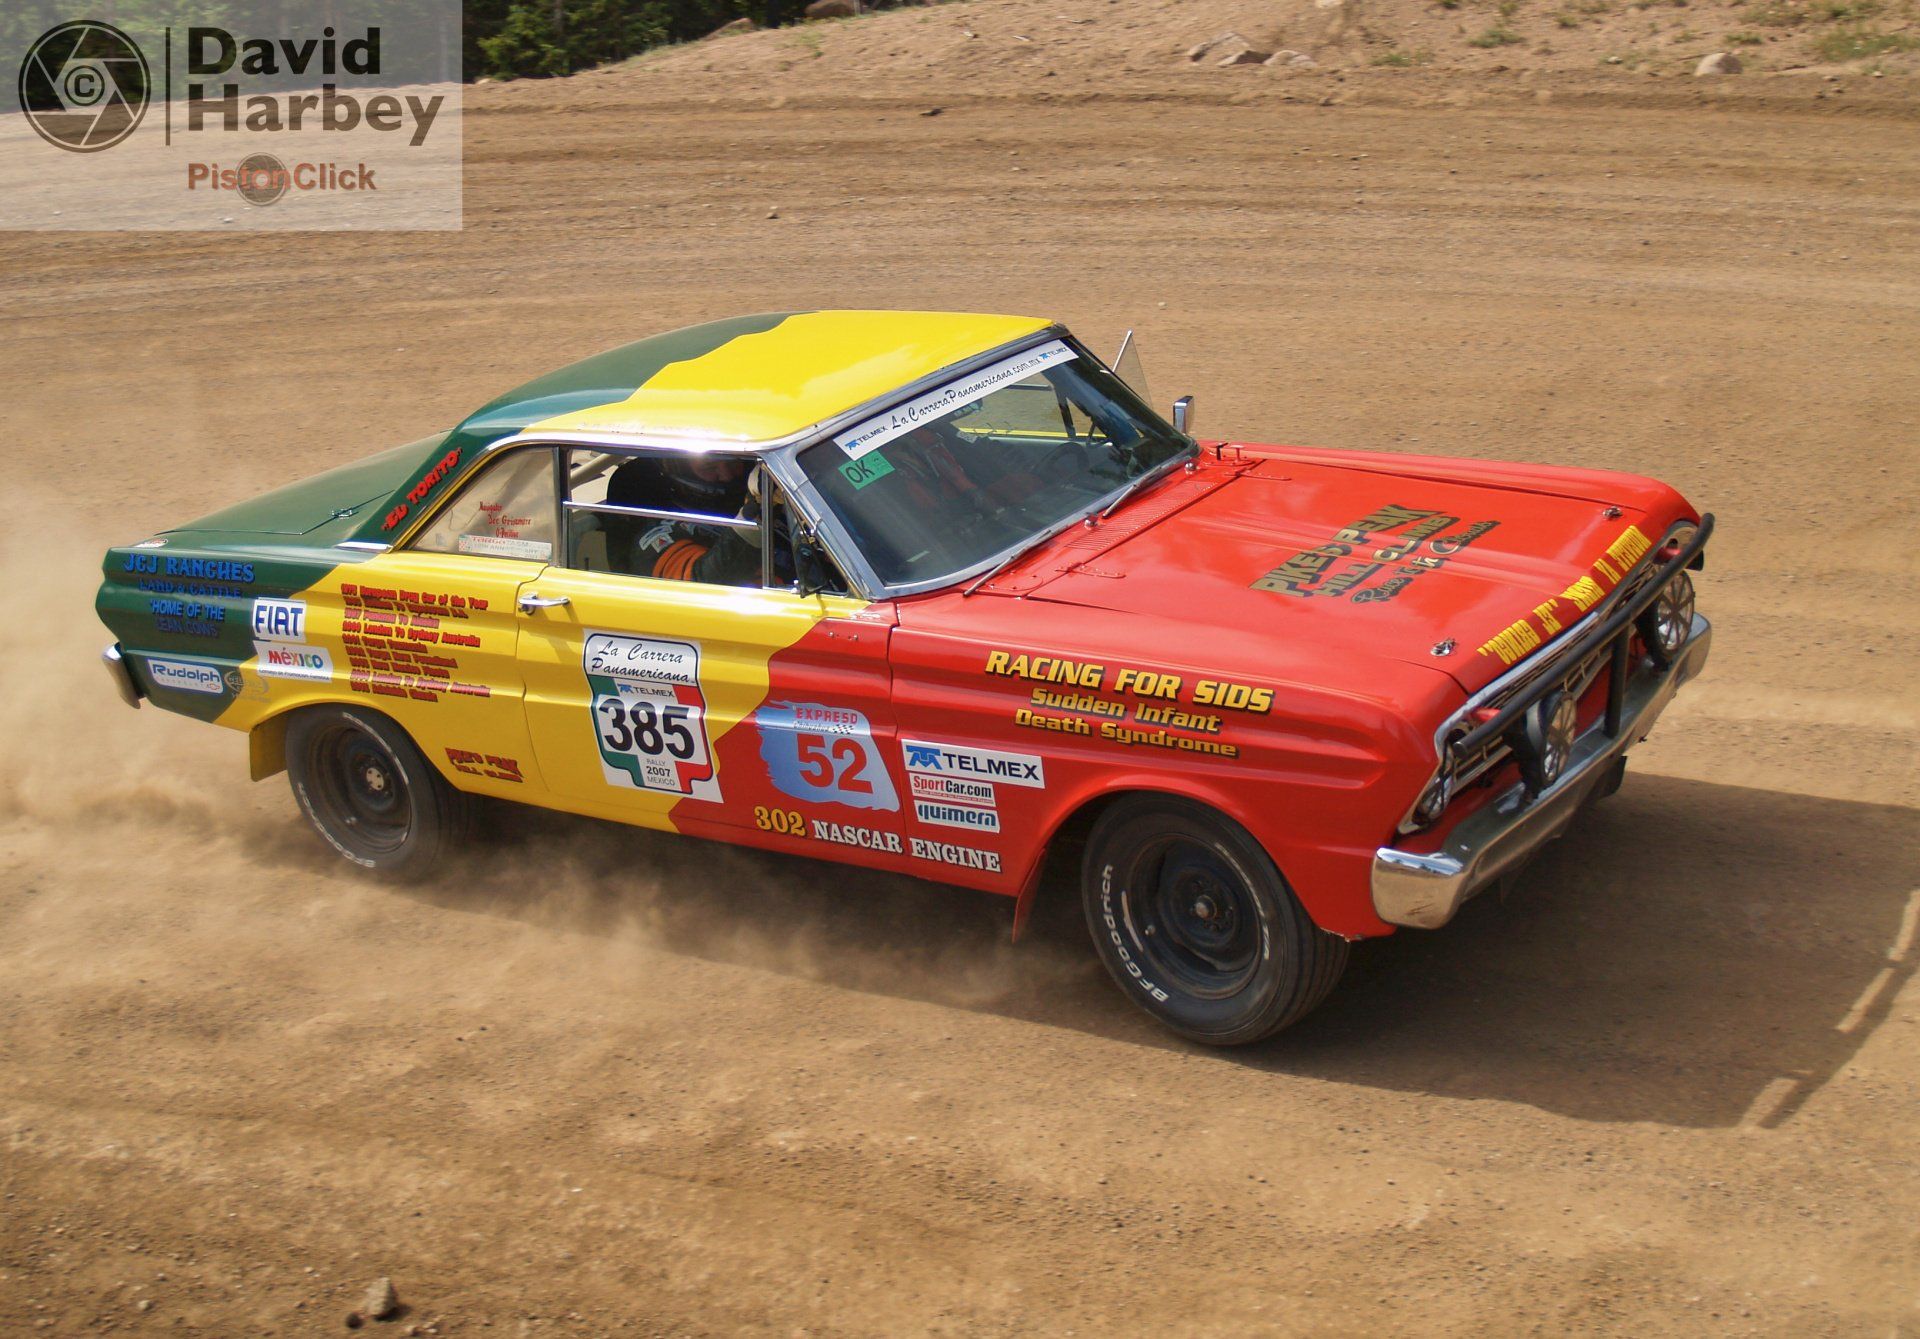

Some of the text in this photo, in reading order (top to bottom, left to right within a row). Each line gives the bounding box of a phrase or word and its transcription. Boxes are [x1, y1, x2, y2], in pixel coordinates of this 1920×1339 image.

[858, 425, 888, 443] TELMEX
[846, 460, 875, 483] OK
[124, 553, 255, 583] JCJ RANCHES
[1311, 516, 1460, 597] HILL CLIMB
[186, 602, 202, 618] OF
[205, 604, 226, 621] THE
[255, 605, 303, 636] FIAT
[598, 640, 683, 664] La Carrera
[153, 664, 220, 683] Rudolph
[591, 657, 690, 683] Panamericana
[985, 650, 1275, 713] RACING FOR SIDS
[634, 686, 675, 698] TELMEX
[1030, 687, 1222, 733] Sudden Infant
[599, 698, 695, 759] 385
[1015, 709, 1239, 757] Death Syndrome
[646, 758, 666, 766] RALLY
[646, 766, 671, 778] 2007
[797, 733, 873, 794] 52
[943, 752, 1040, 781] TELMEX
[647, 777, 675, 786] MEXICO
[913, 775, 992, 798] SportCar.com
[918, 804, 997, 827] quimera
[754, 806, 1001, 873] 302 NASCAR ENGINE
